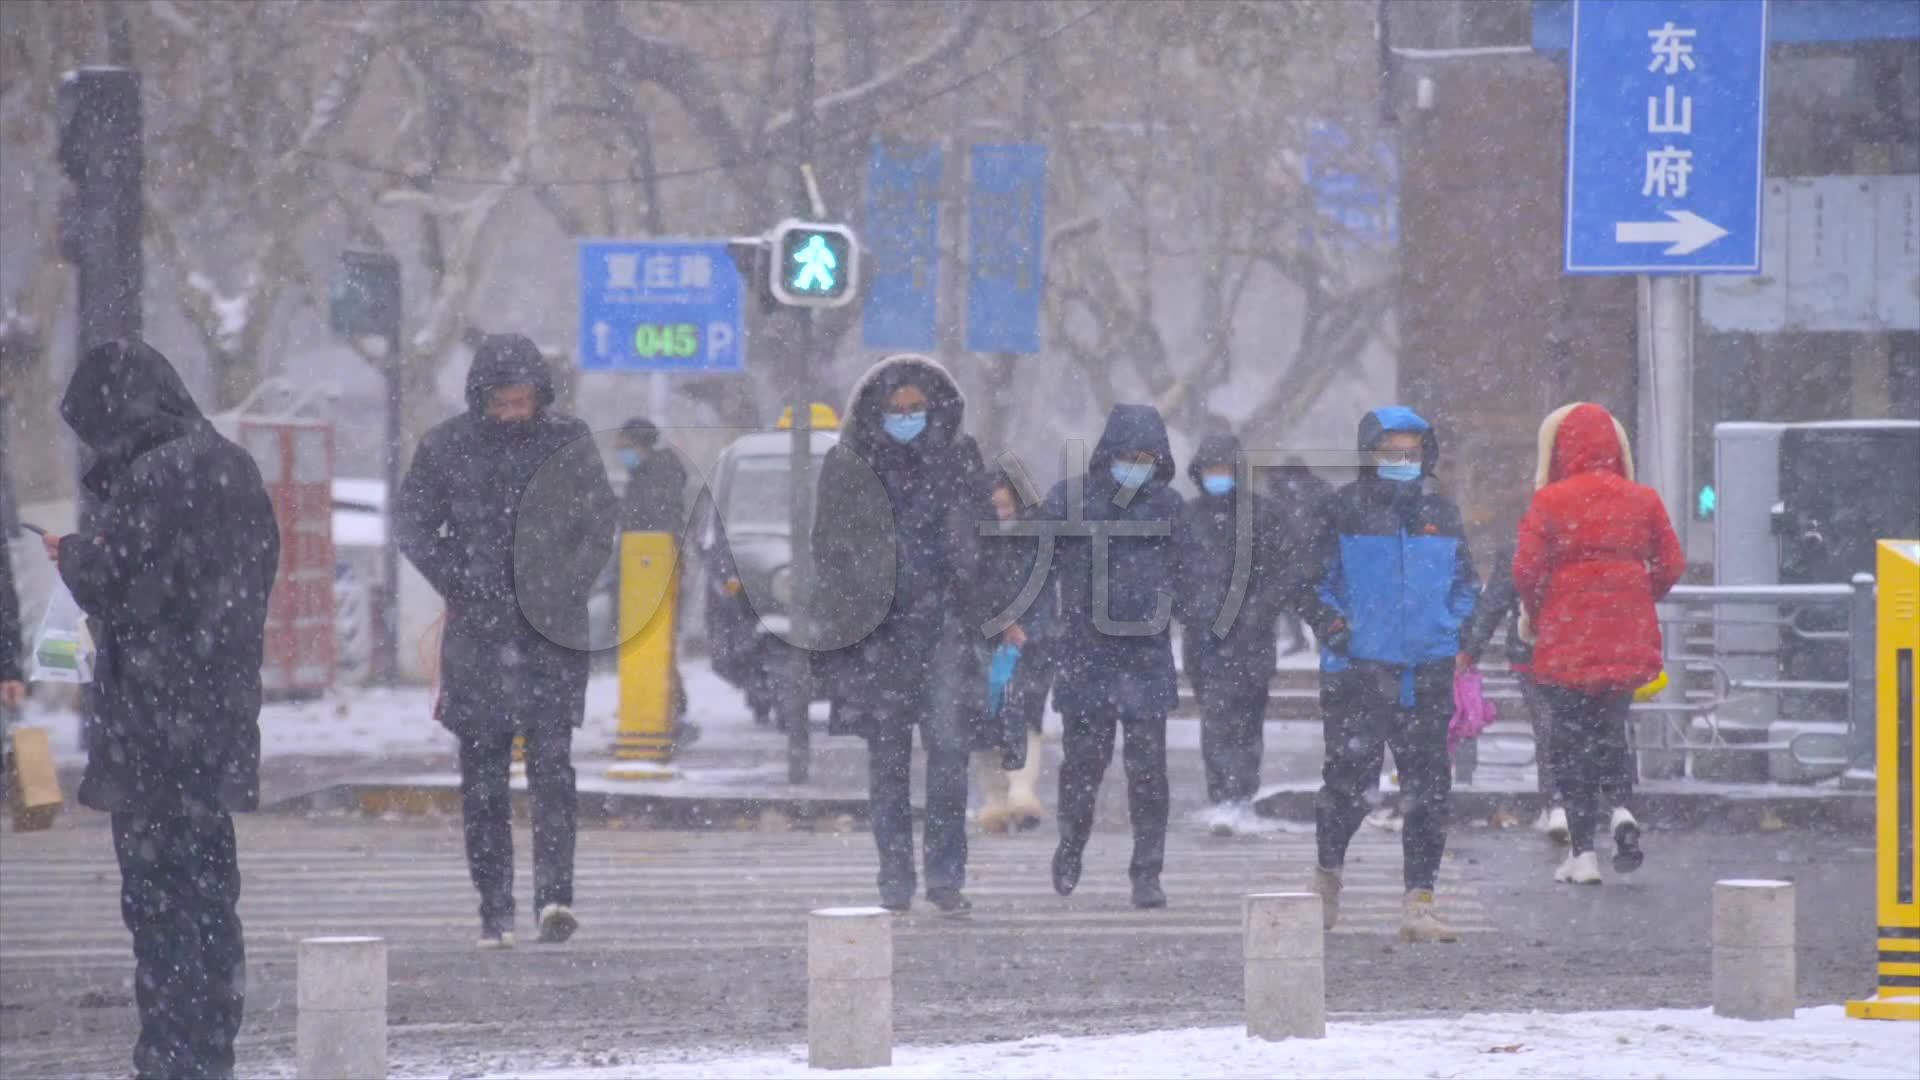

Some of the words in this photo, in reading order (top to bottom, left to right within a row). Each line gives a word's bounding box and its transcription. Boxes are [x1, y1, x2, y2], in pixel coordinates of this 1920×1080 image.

[1642, 21, 1697, 198] 东山府
[635, 322, 698, 358] 045
[707, 322, 734, 362] P
